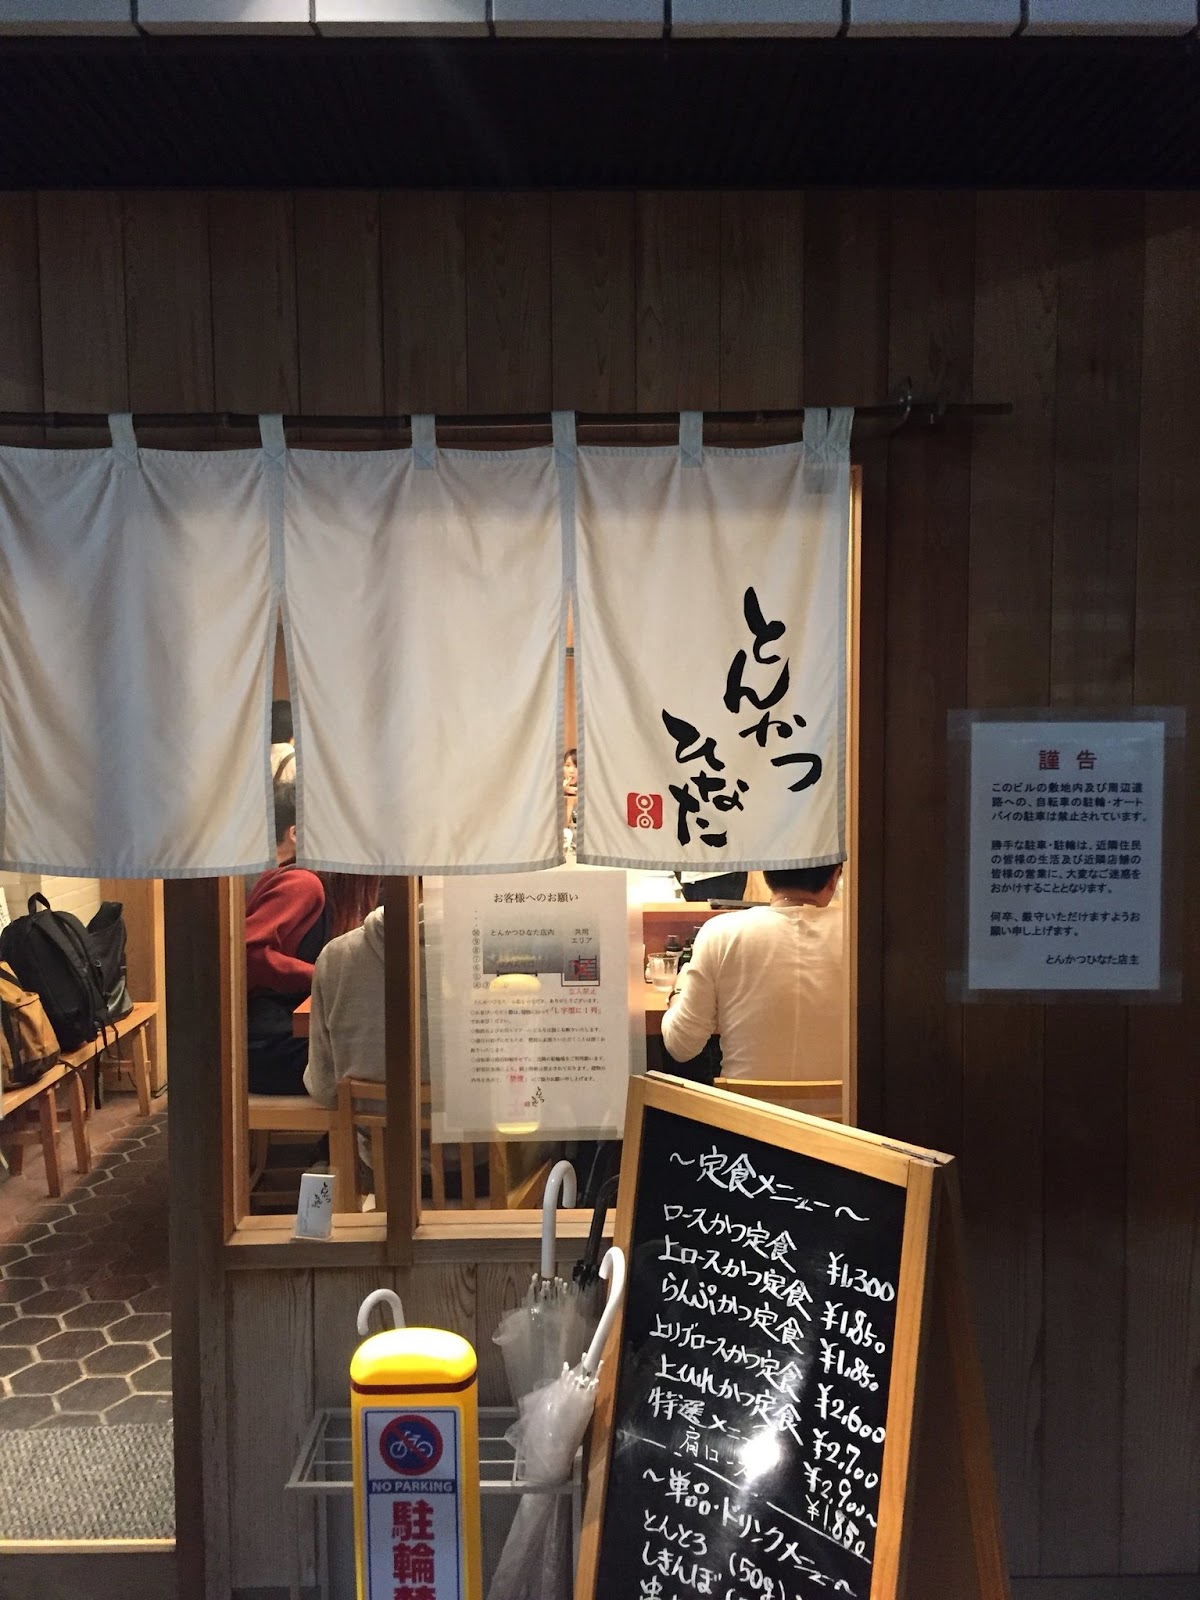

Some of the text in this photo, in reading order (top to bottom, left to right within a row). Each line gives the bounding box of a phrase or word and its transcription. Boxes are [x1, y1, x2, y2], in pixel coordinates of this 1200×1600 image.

[723, 586, 822, 792] とんかつ
[662, 709, 750, 847] ひなた
[1038, 750, 1097, 770] 謹告
[493, 892, 579, 903] お客様へのお願い
[1046, 954, 1140, 965] とんかつひなた店主
[664, 1204, 798, 1273] ロースかつ定食
[658, 1234, 813, 1321] 上ロースかつ定食
[661, 1272, 804, 1354] らんぷかつ定食
[372, 1481, 453, 1492] NO PARKING
